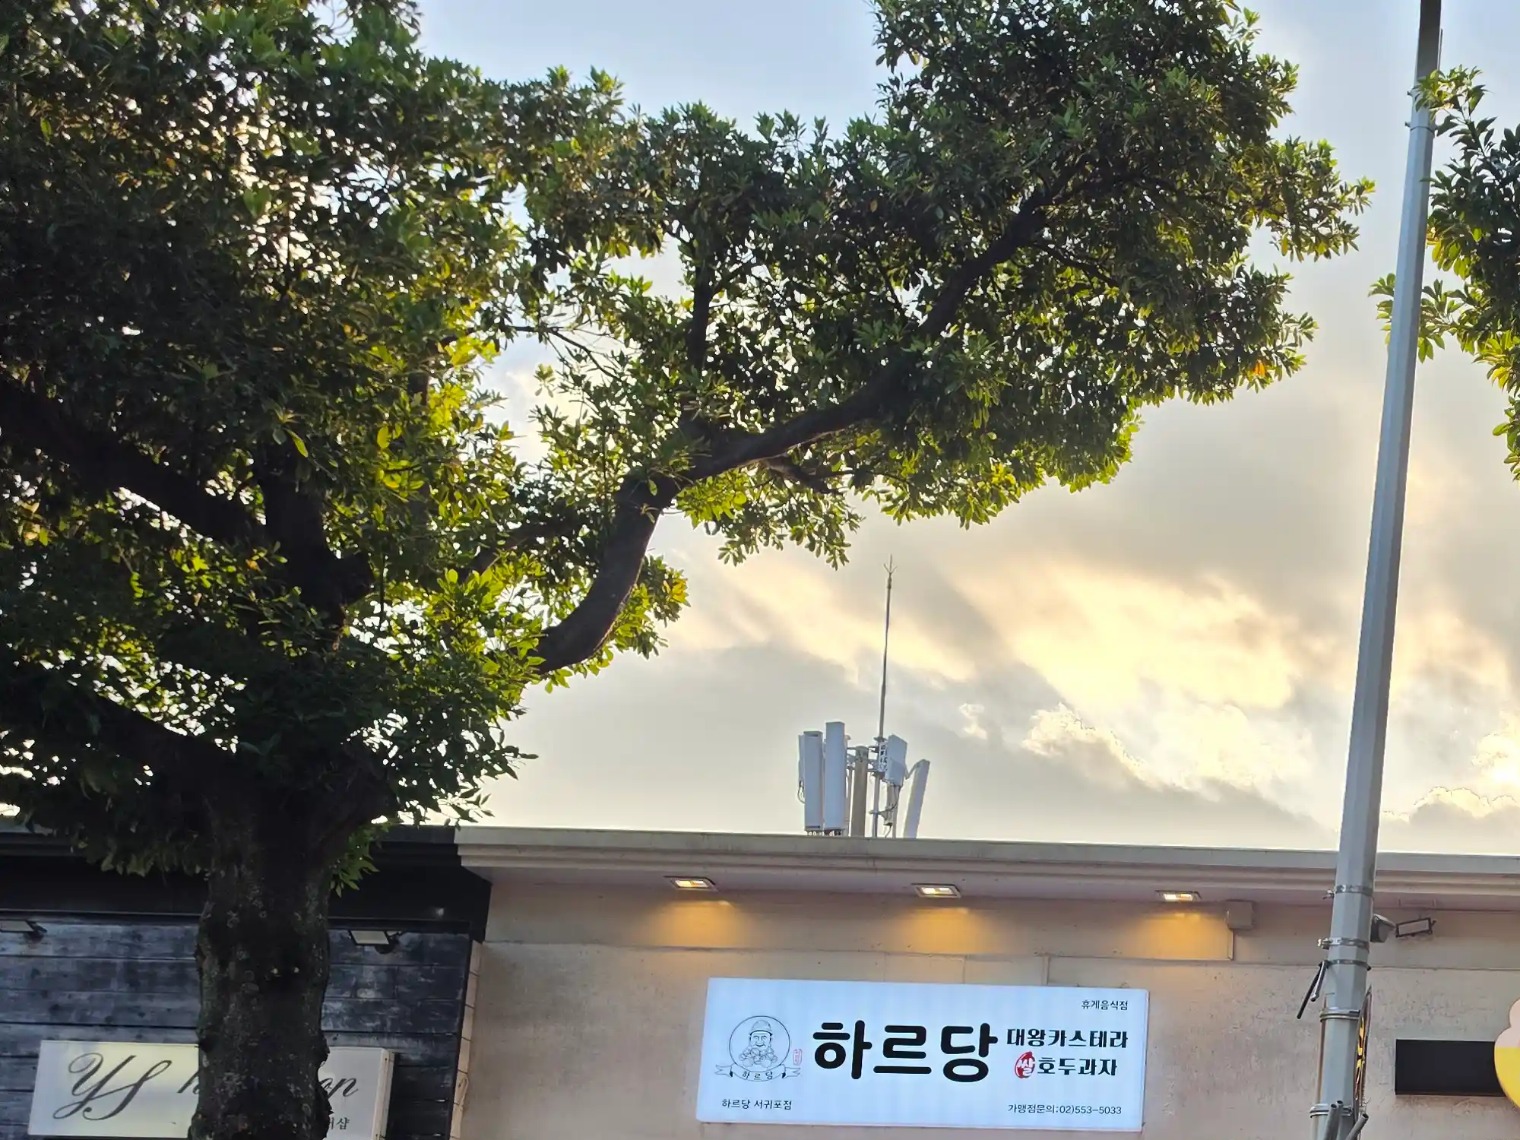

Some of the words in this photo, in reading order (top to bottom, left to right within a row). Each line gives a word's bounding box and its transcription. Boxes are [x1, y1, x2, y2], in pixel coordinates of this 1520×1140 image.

[1081, 1000, 1129, 1011] 휴게음식점
[1006, 1028, 1129, 1049] 대왕카스테라
[813, 1020, 998, 1083] 하르당
[1037, 1057, 1118, 1077] 호두과자
[721, 1099, 751, 1110] 하르당
[754, 1100, 792, 1111] 서귀포점
